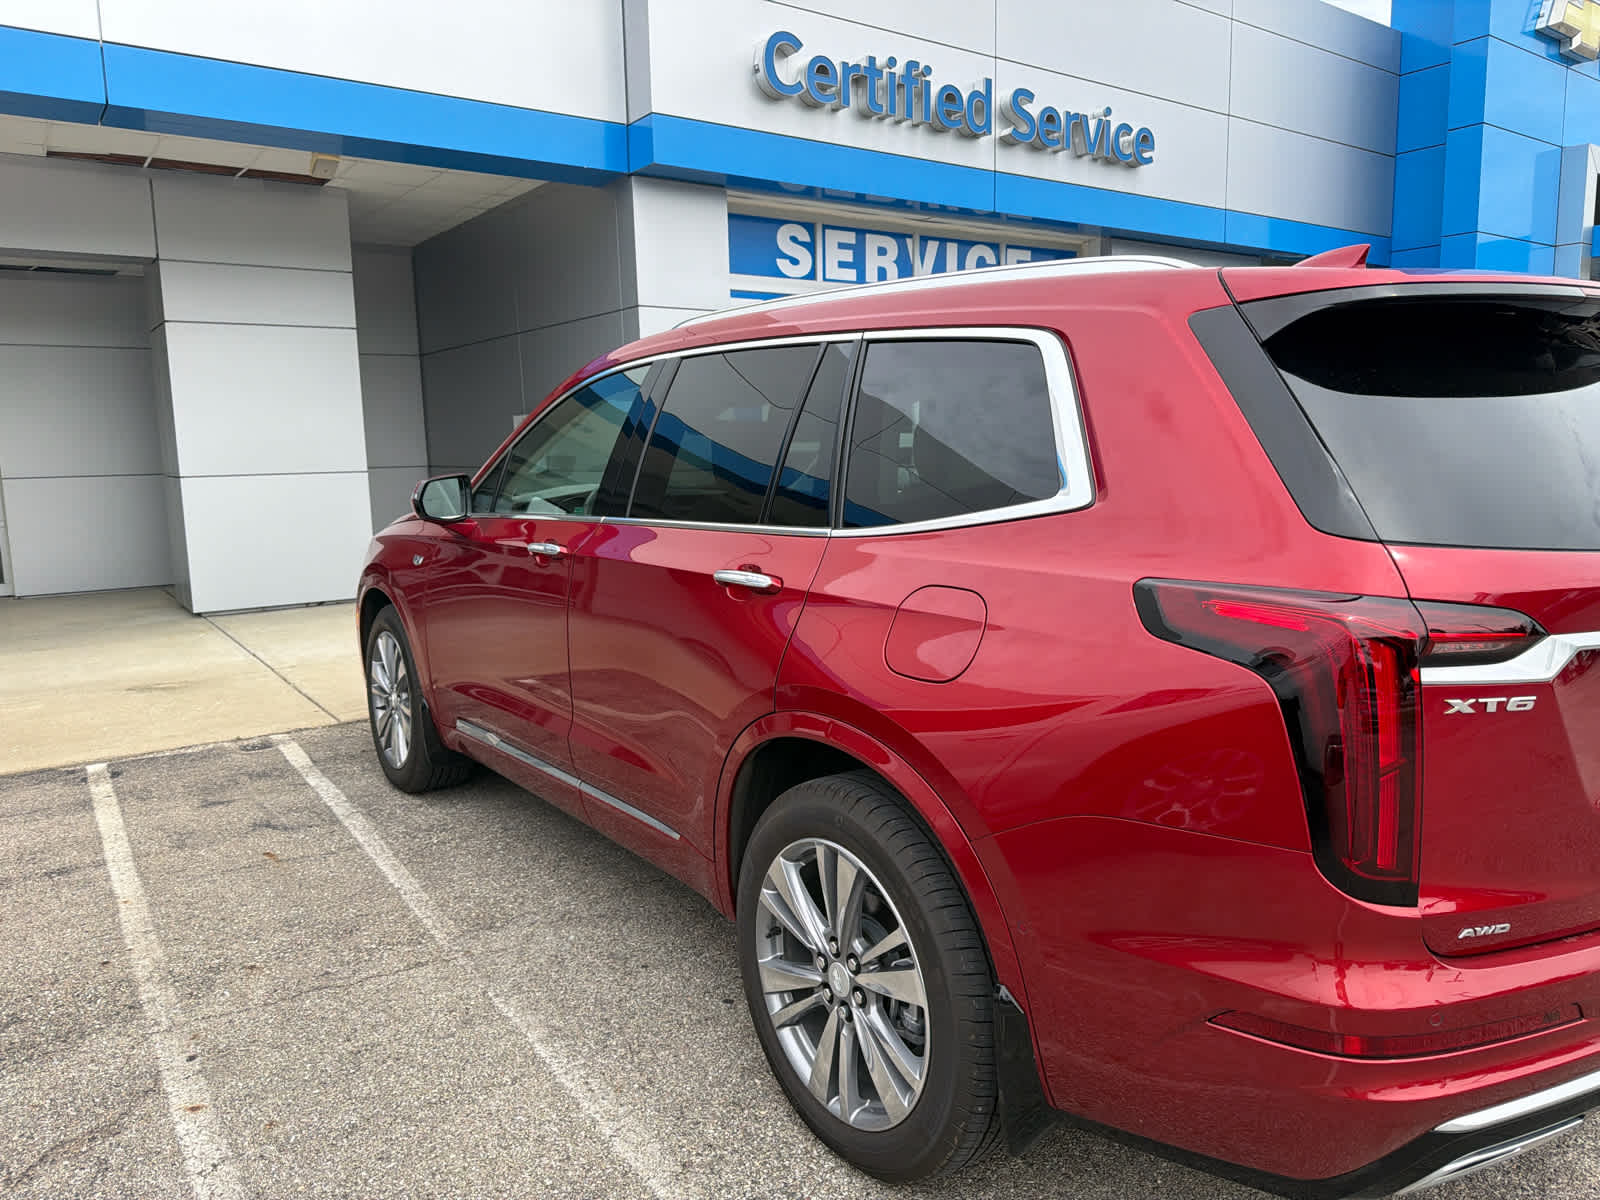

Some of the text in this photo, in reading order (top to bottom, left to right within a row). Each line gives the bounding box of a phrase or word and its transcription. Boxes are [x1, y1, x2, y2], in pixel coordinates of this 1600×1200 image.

[761, 31, 1156, 166] Certified Service
[1443, 696, 1537, 714] XT6
[1458, 923, 1511, 939] AWD
